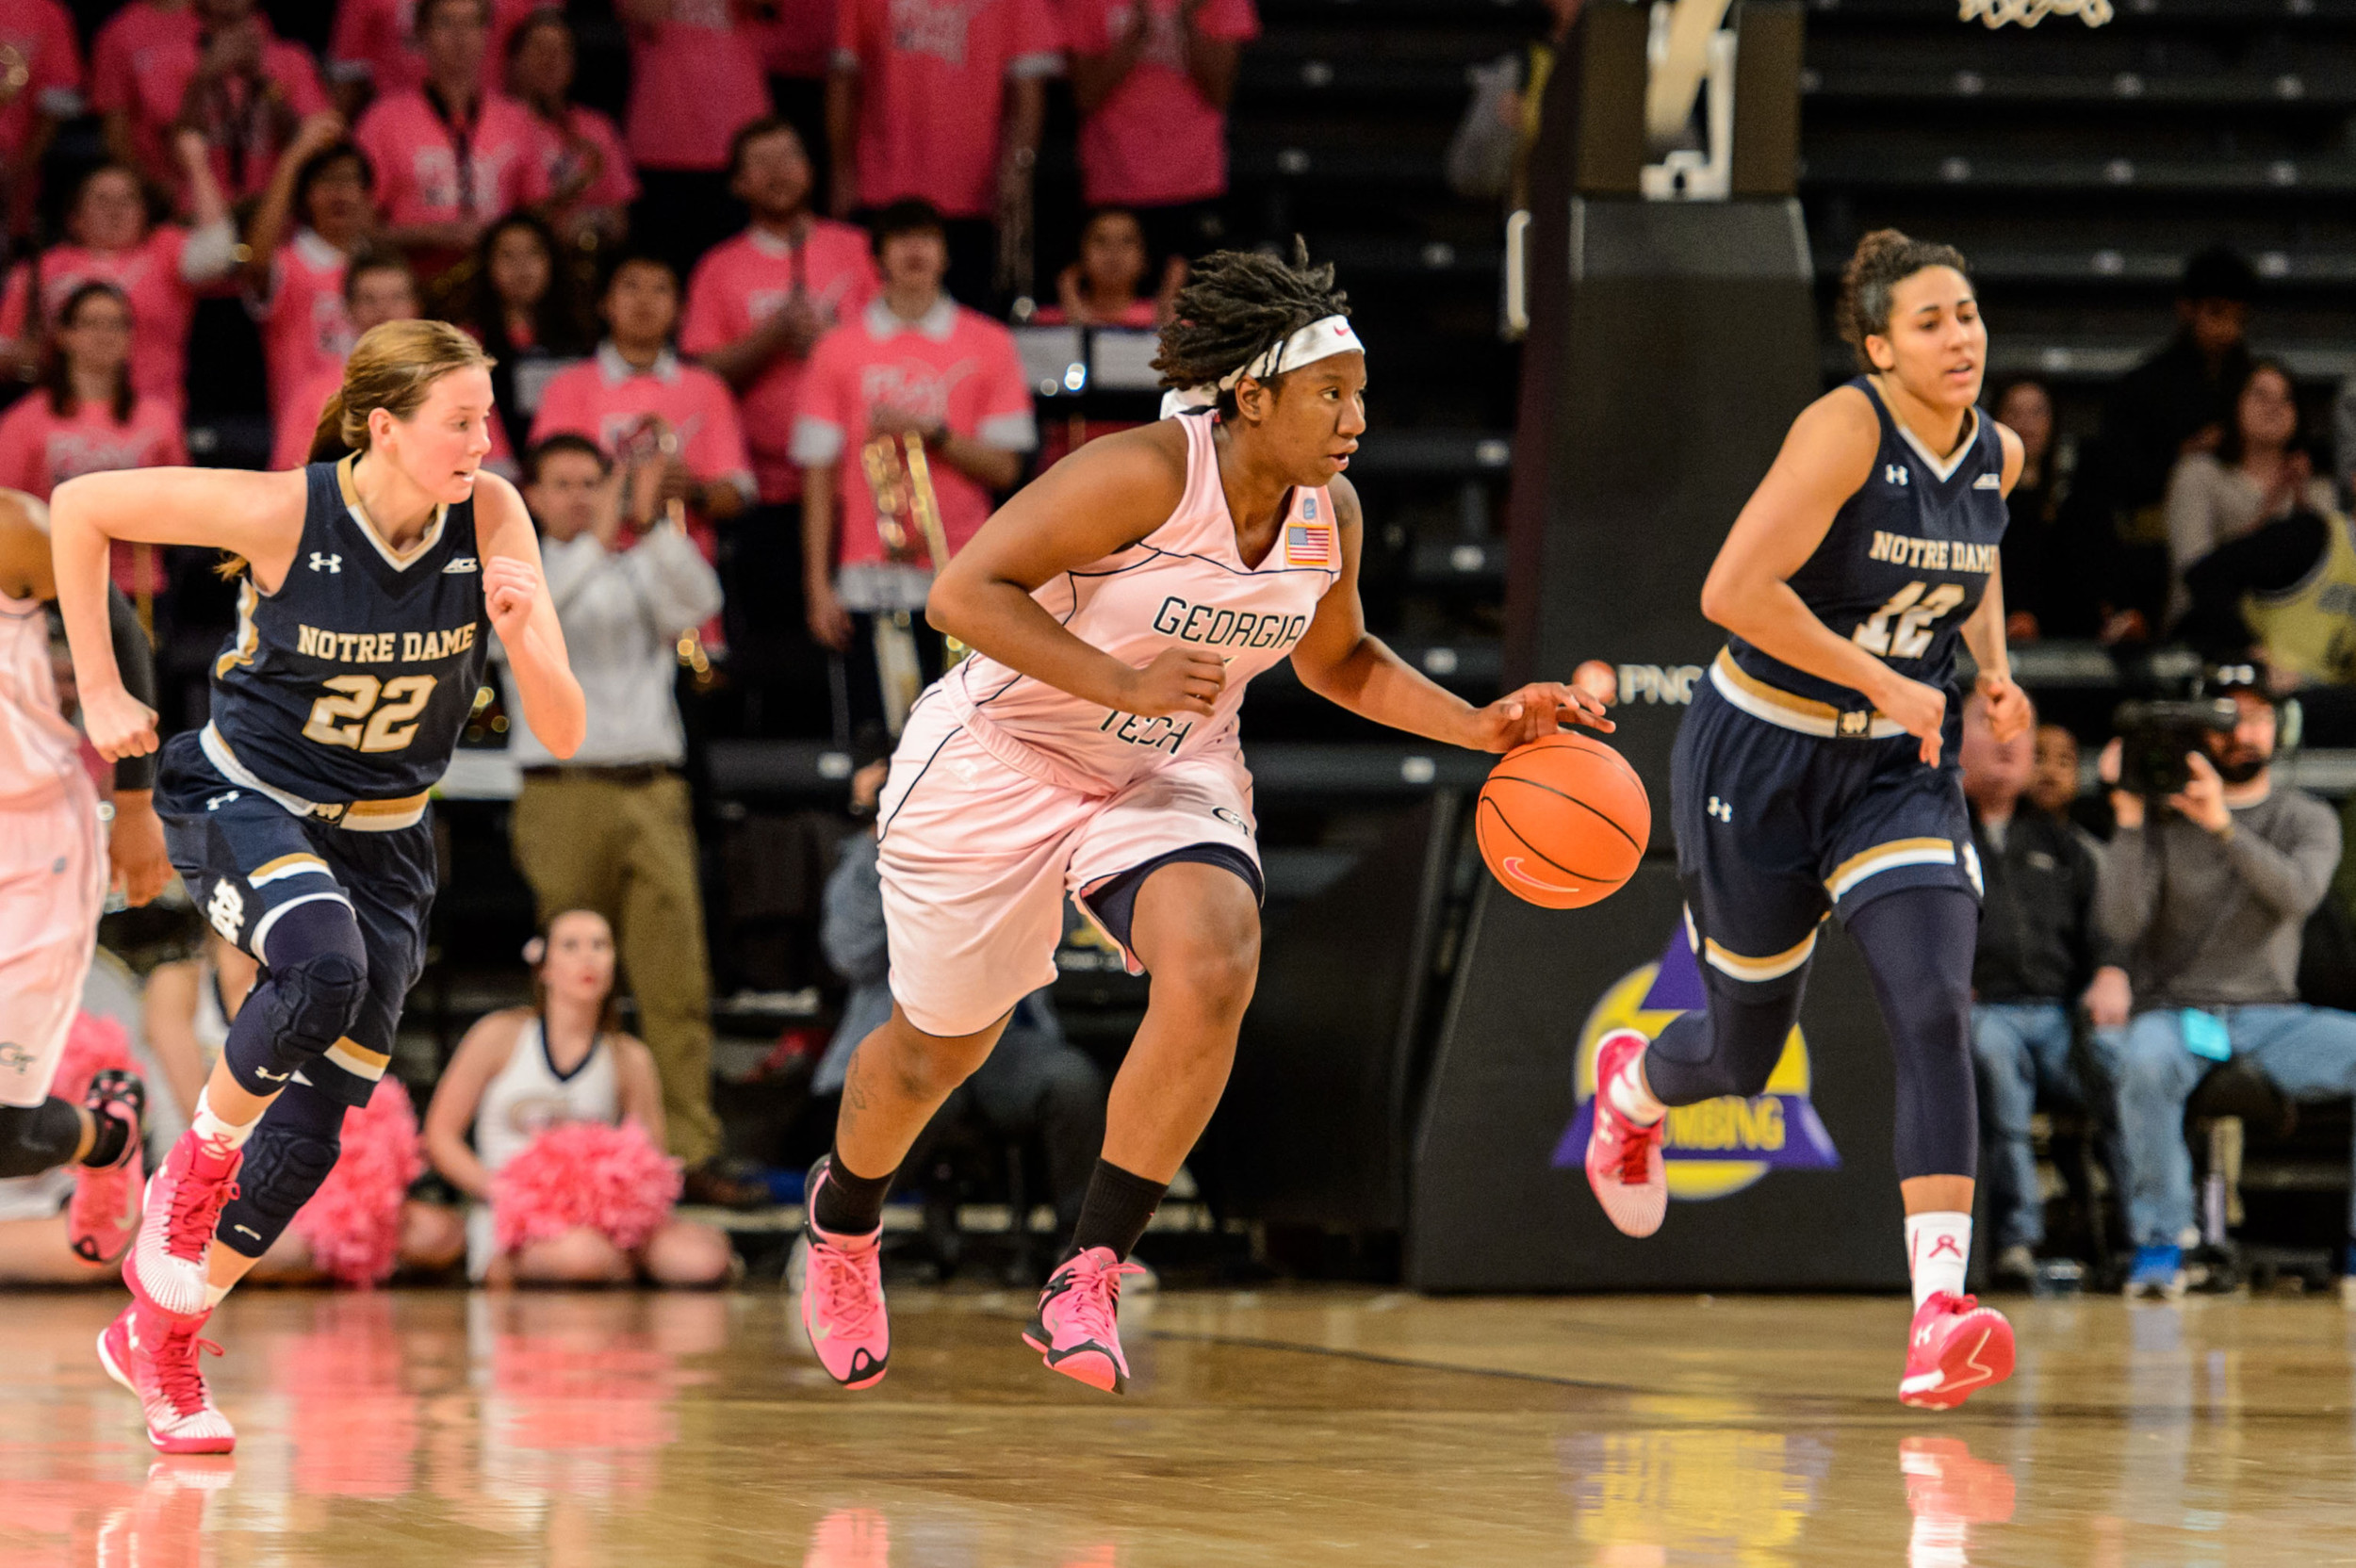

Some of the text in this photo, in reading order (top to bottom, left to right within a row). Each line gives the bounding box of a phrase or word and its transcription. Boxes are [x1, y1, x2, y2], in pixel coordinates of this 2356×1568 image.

[1869, 531, 1949, 571] NOTRE
[298, 621, 477, 662] NOTRE DAME
[1153, 596, 1307, 648] GEORGIA
[1851, 580, 1965, 660] 12
[1618, 664, 1704, 705] PNC
[302, 674, 438, 753] 22
[1662, 1095, 1786, 1151] MBING
